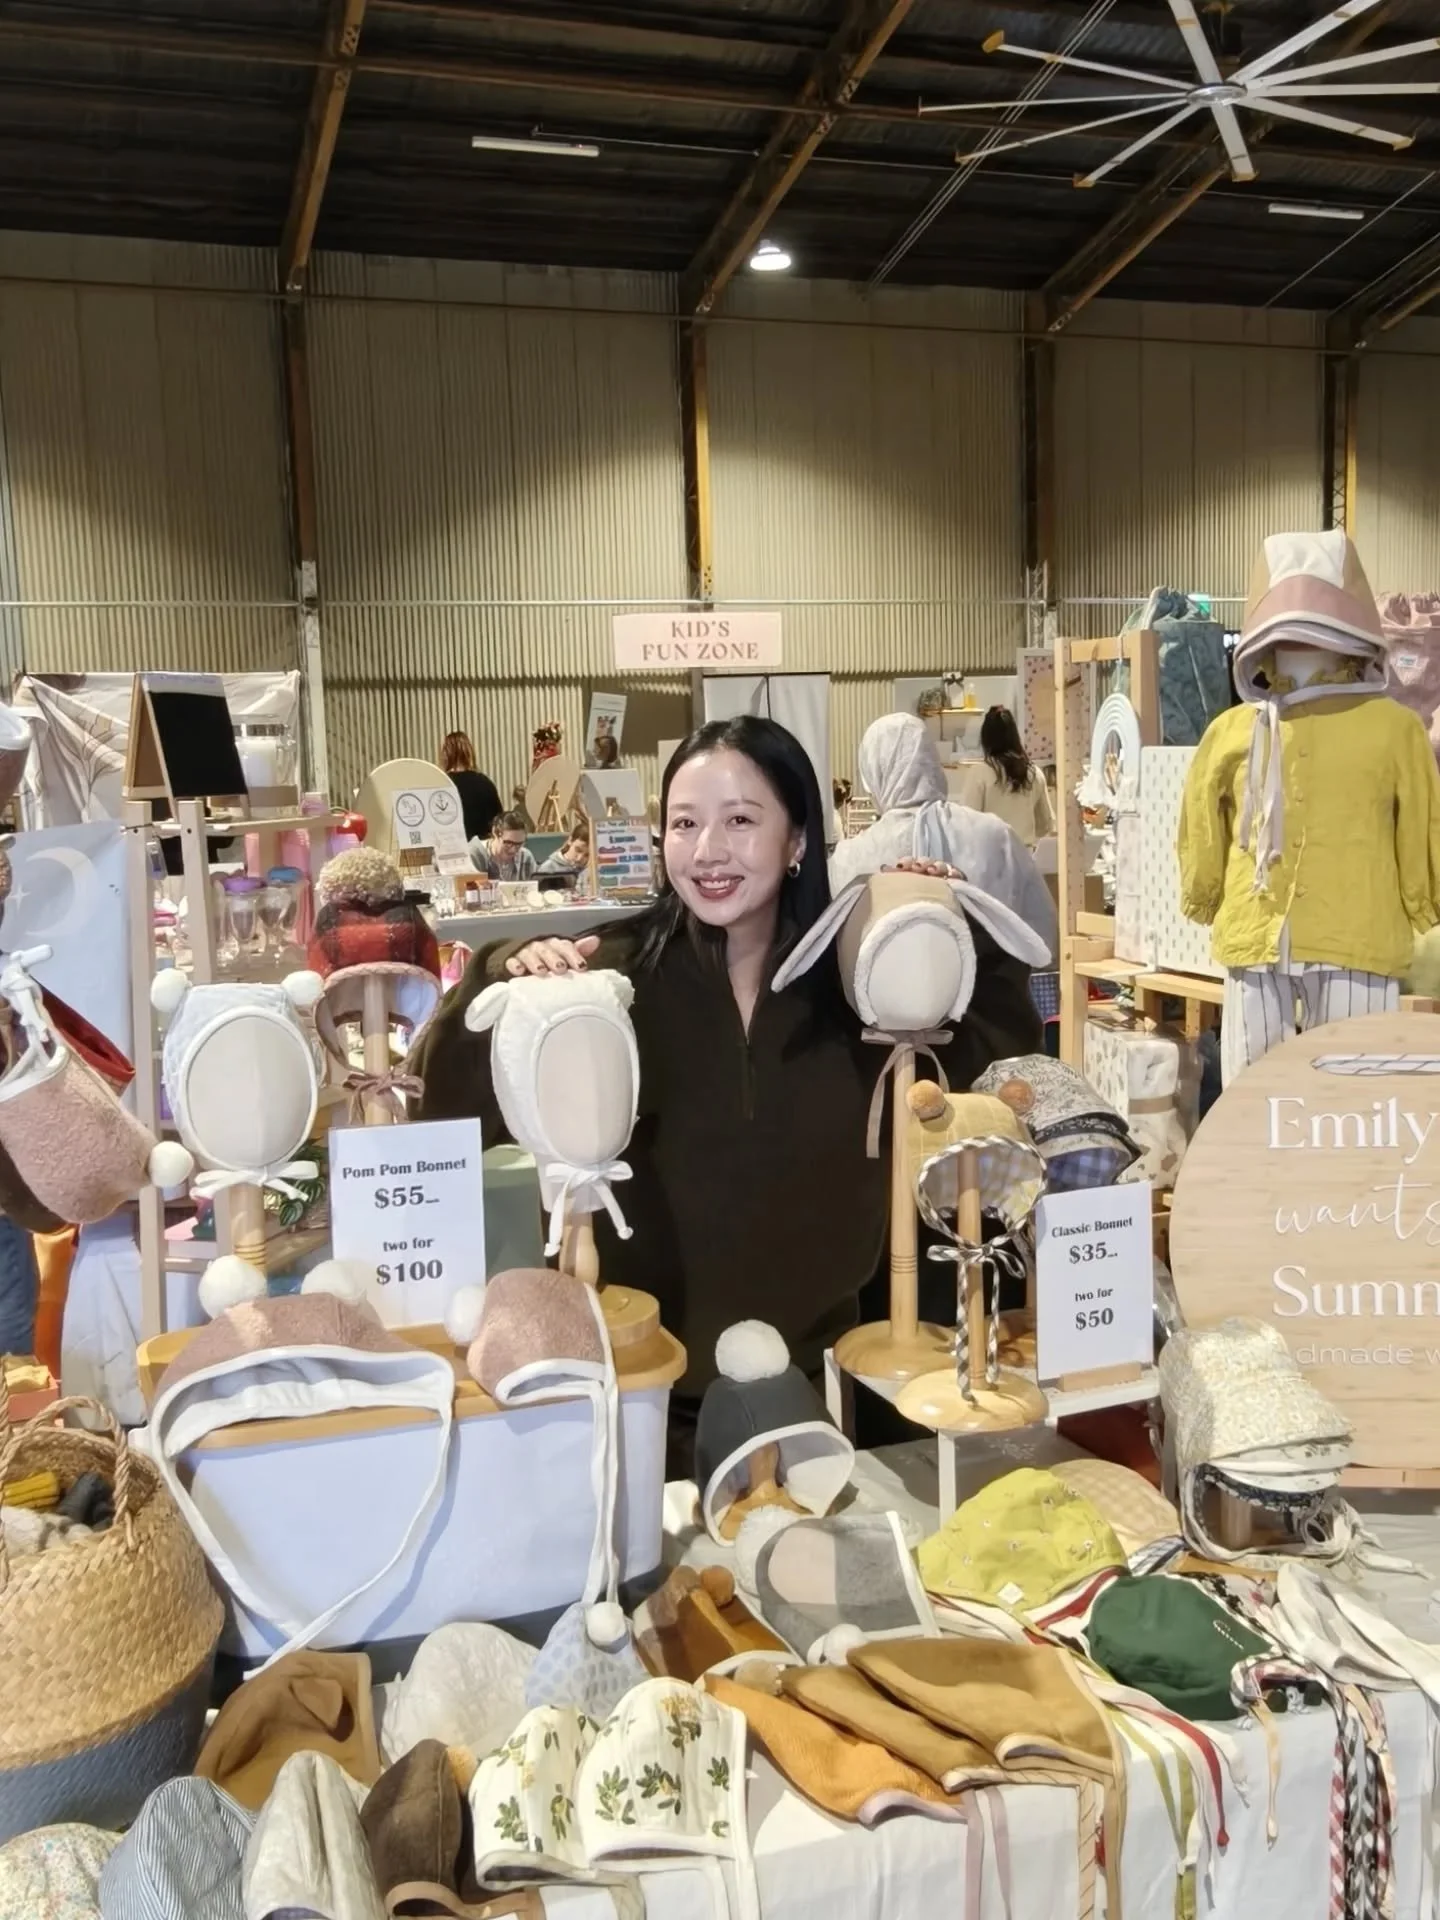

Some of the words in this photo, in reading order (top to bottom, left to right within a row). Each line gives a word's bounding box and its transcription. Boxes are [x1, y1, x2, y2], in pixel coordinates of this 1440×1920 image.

[671, 620, 730, 639] KID'S
[642, 643, 688, 661] FUN
[697, 642, 759, 660] ZONE
[1267, 1096, 1440, 1164] Emily
[342, 1166, 375, 1179] Pom
[380, 1163, 412, 1176] Pom
[416, 1158, 467, 1173] Bonnet
[1051, 1222, 1091, 1238] Classic
[1094, 1216, 1133, 1232] Bonnet
[383, 1241, 407, 1252] two
[412, 1237, 434, 1249] for
[376, 1259, 443, 1285] $100
[1075, 1292, 1094, 1302] two
[1097, 1288, 1114, 1299] for
[1075, 1307, 1114, 1331] $50
[1296, 1343, 1414, 1365] dmade
